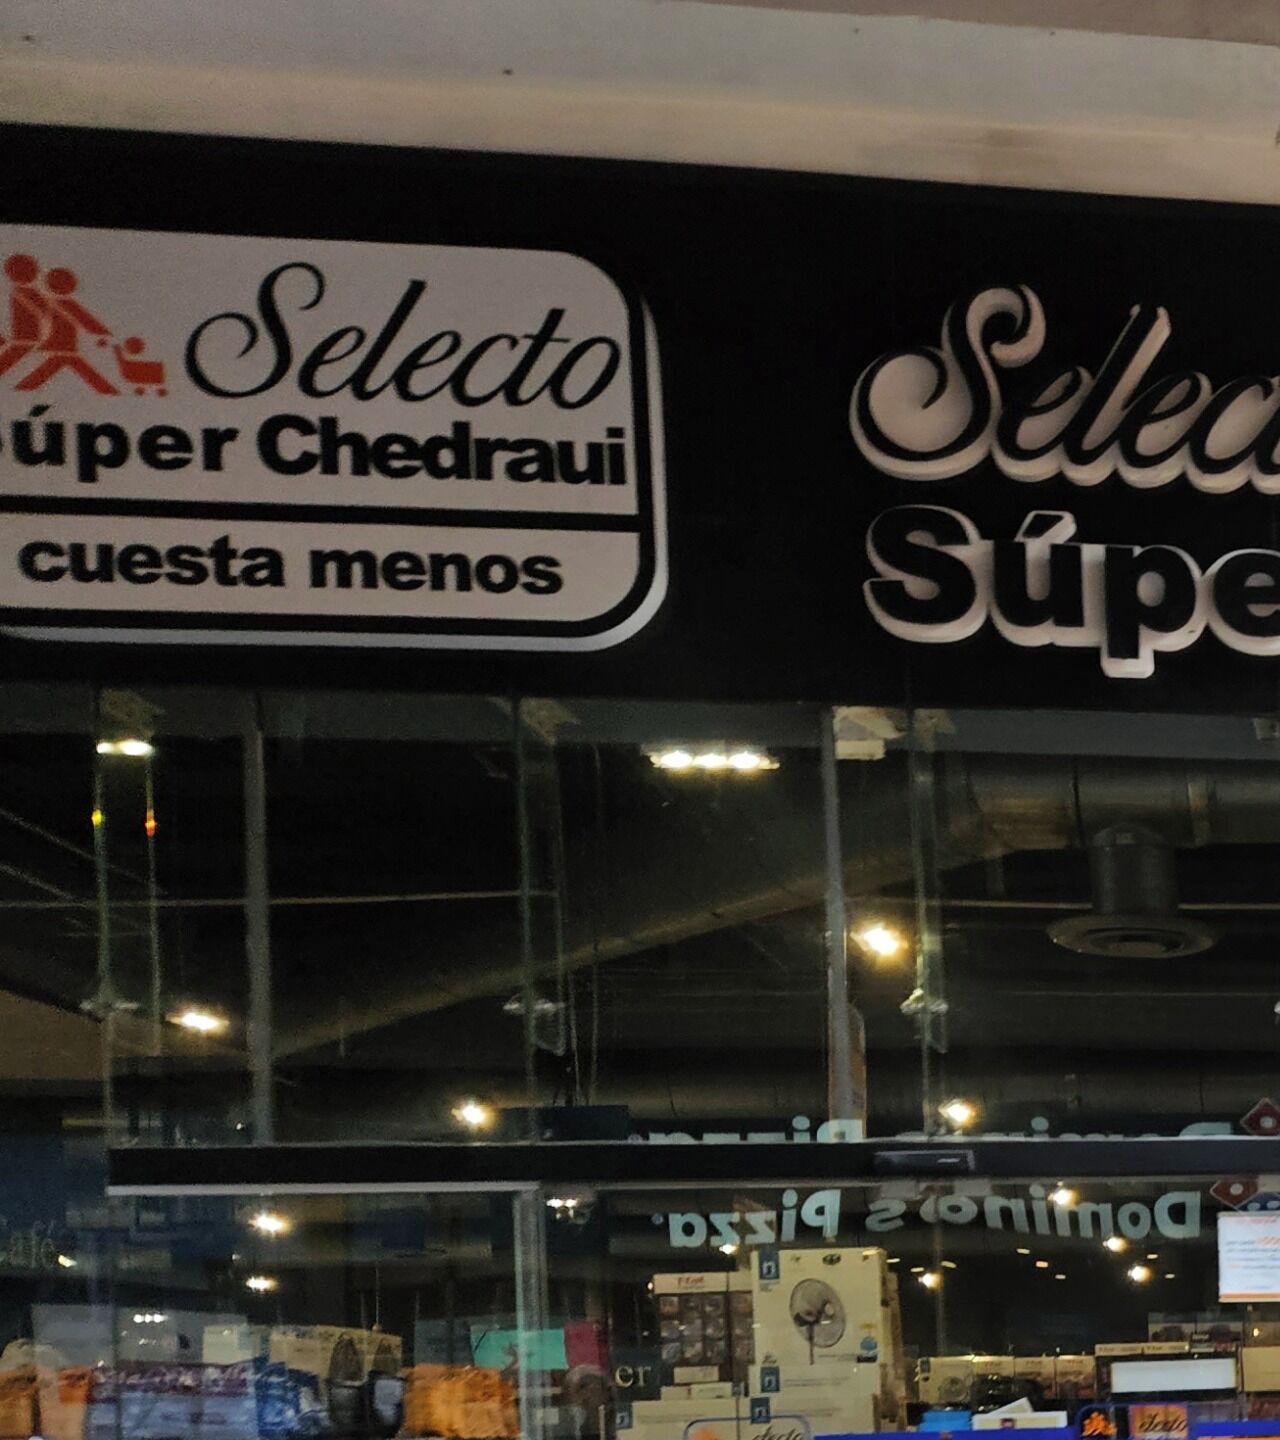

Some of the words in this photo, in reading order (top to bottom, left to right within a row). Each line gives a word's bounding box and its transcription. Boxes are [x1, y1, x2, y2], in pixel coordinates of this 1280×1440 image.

[184, 261, 622, 410] Selecto
[0, 404, 239, 483] úper
[257, 413, 627, 486] Chedraui
[18, 535, 285, 589] cuesta
[309, 546, 564, 596] menos
